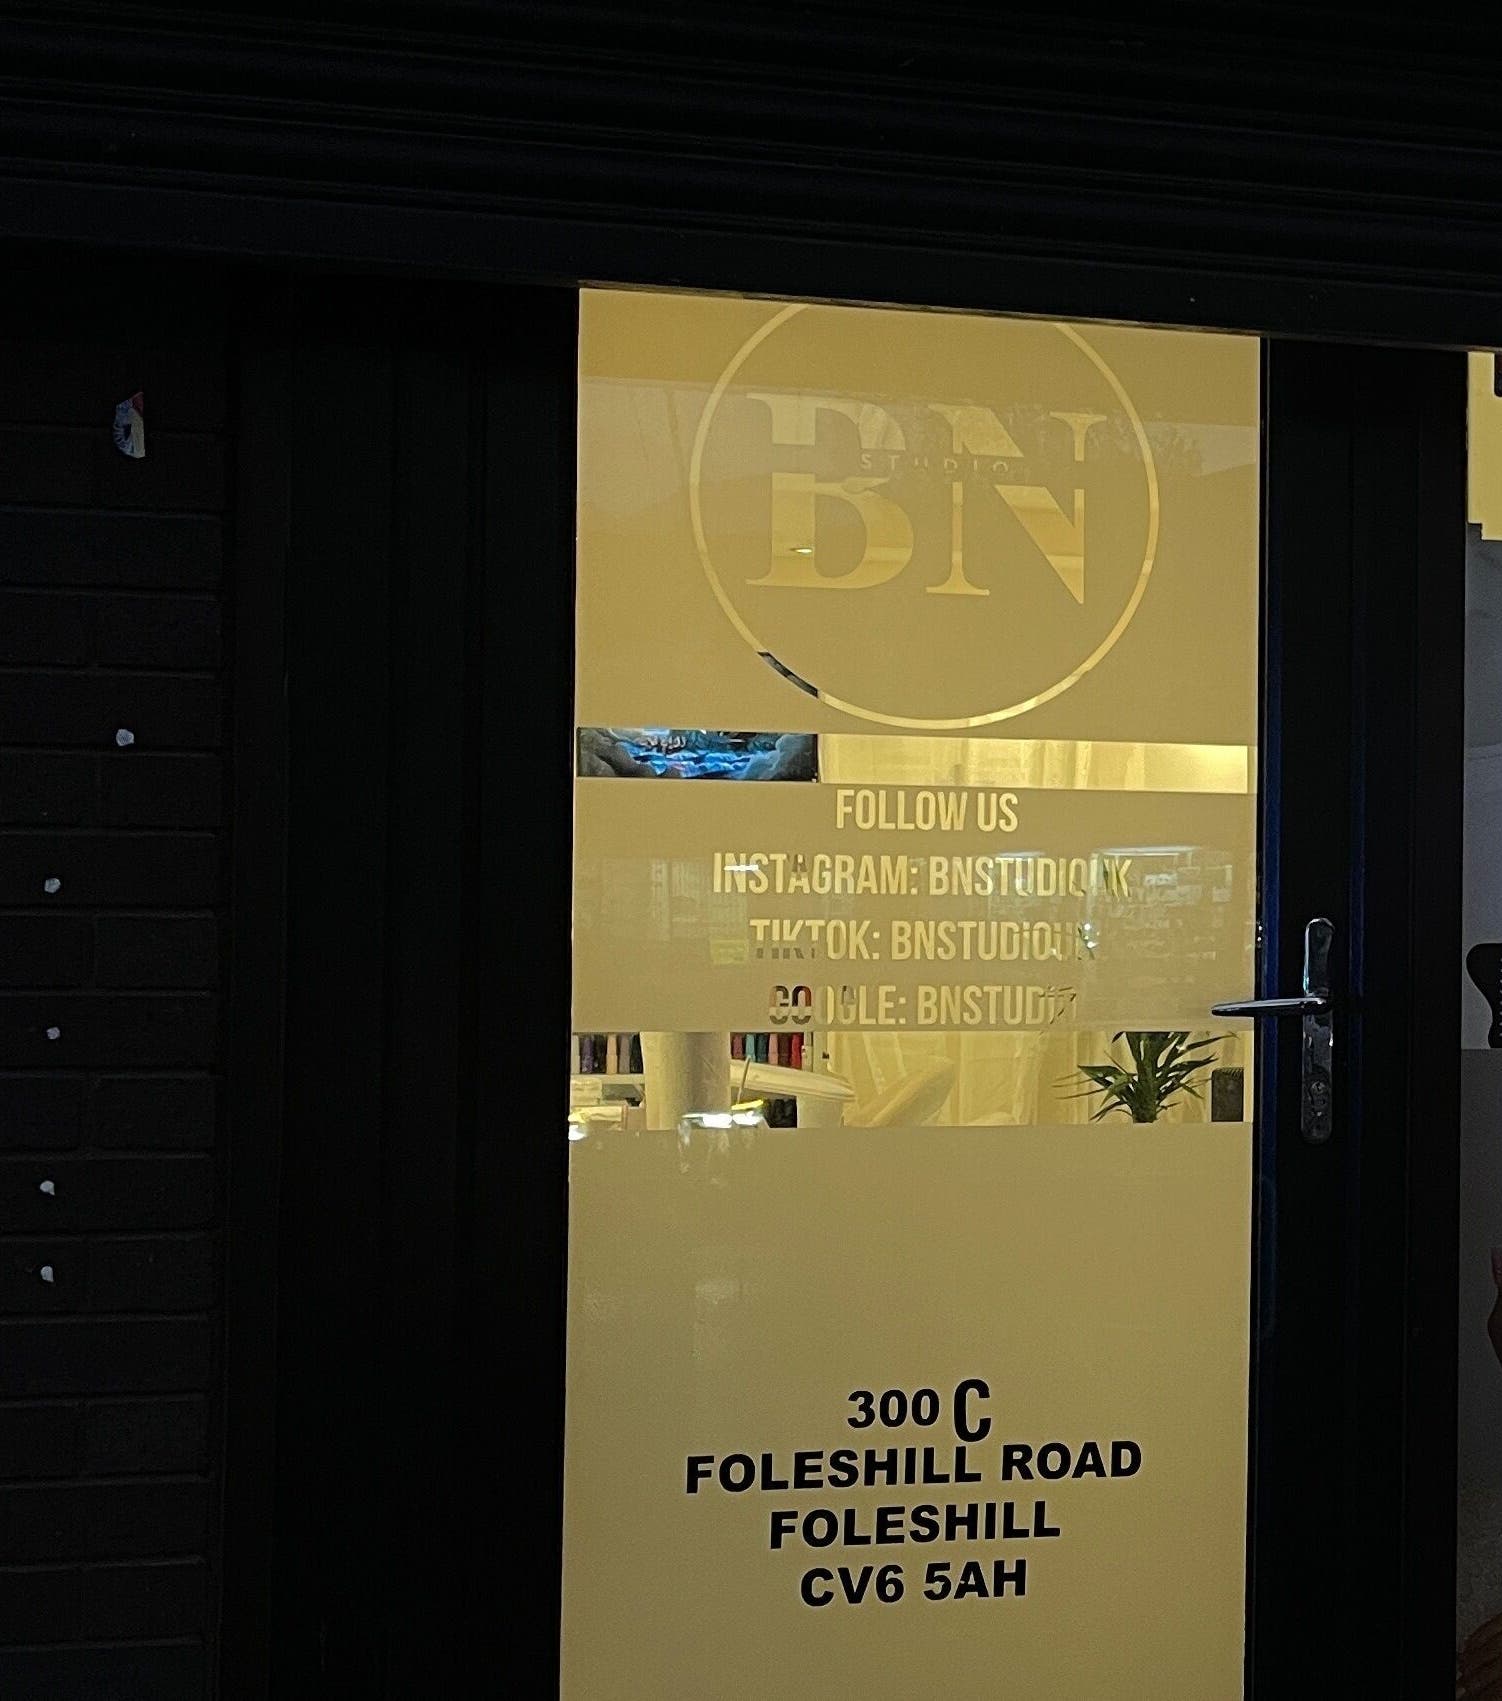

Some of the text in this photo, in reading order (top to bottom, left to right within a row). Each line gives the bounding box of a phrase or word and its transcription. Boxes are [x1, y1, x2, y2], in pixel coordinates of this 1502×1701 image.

[859, 450, 1011, 473] STUDIO
[745, 392, 1108, 605] BN
[836, 789, 1019, 832] FOLLOW US
[713, 853, 919, 896] INSTAGRAM:
[748, 919, 881, 960] TIKTOK:
[847, 1378, 992, 1443] 300 C
[685, 1440, 1142, 1494] FOLESHILL ROAD
[769, 1500, 1061, 1549] FOLESHILL
[800, 1559, 1027, 1607] CV6 5AH
